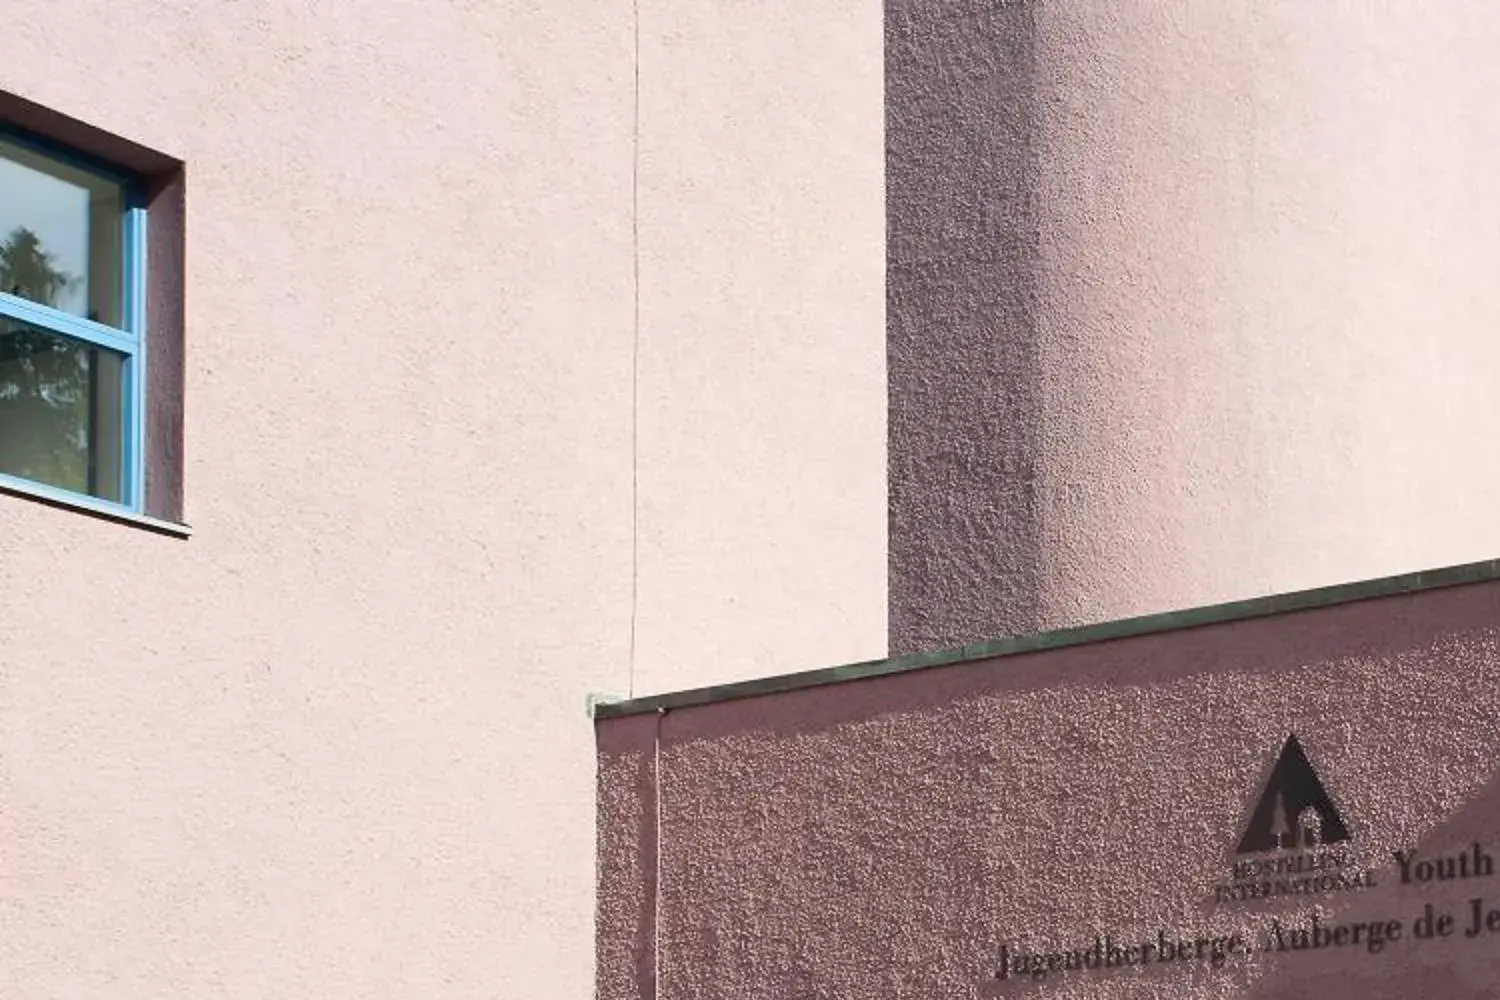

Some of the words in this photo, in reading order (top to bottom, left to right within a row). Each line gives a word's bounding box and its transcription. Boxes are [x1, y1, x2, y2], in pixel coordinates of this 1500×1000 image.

[1395, 843, 1494, 885] Youth
[1265, 912, 1401, 954] Auberge
[1412, 903, 1455, 941] de
